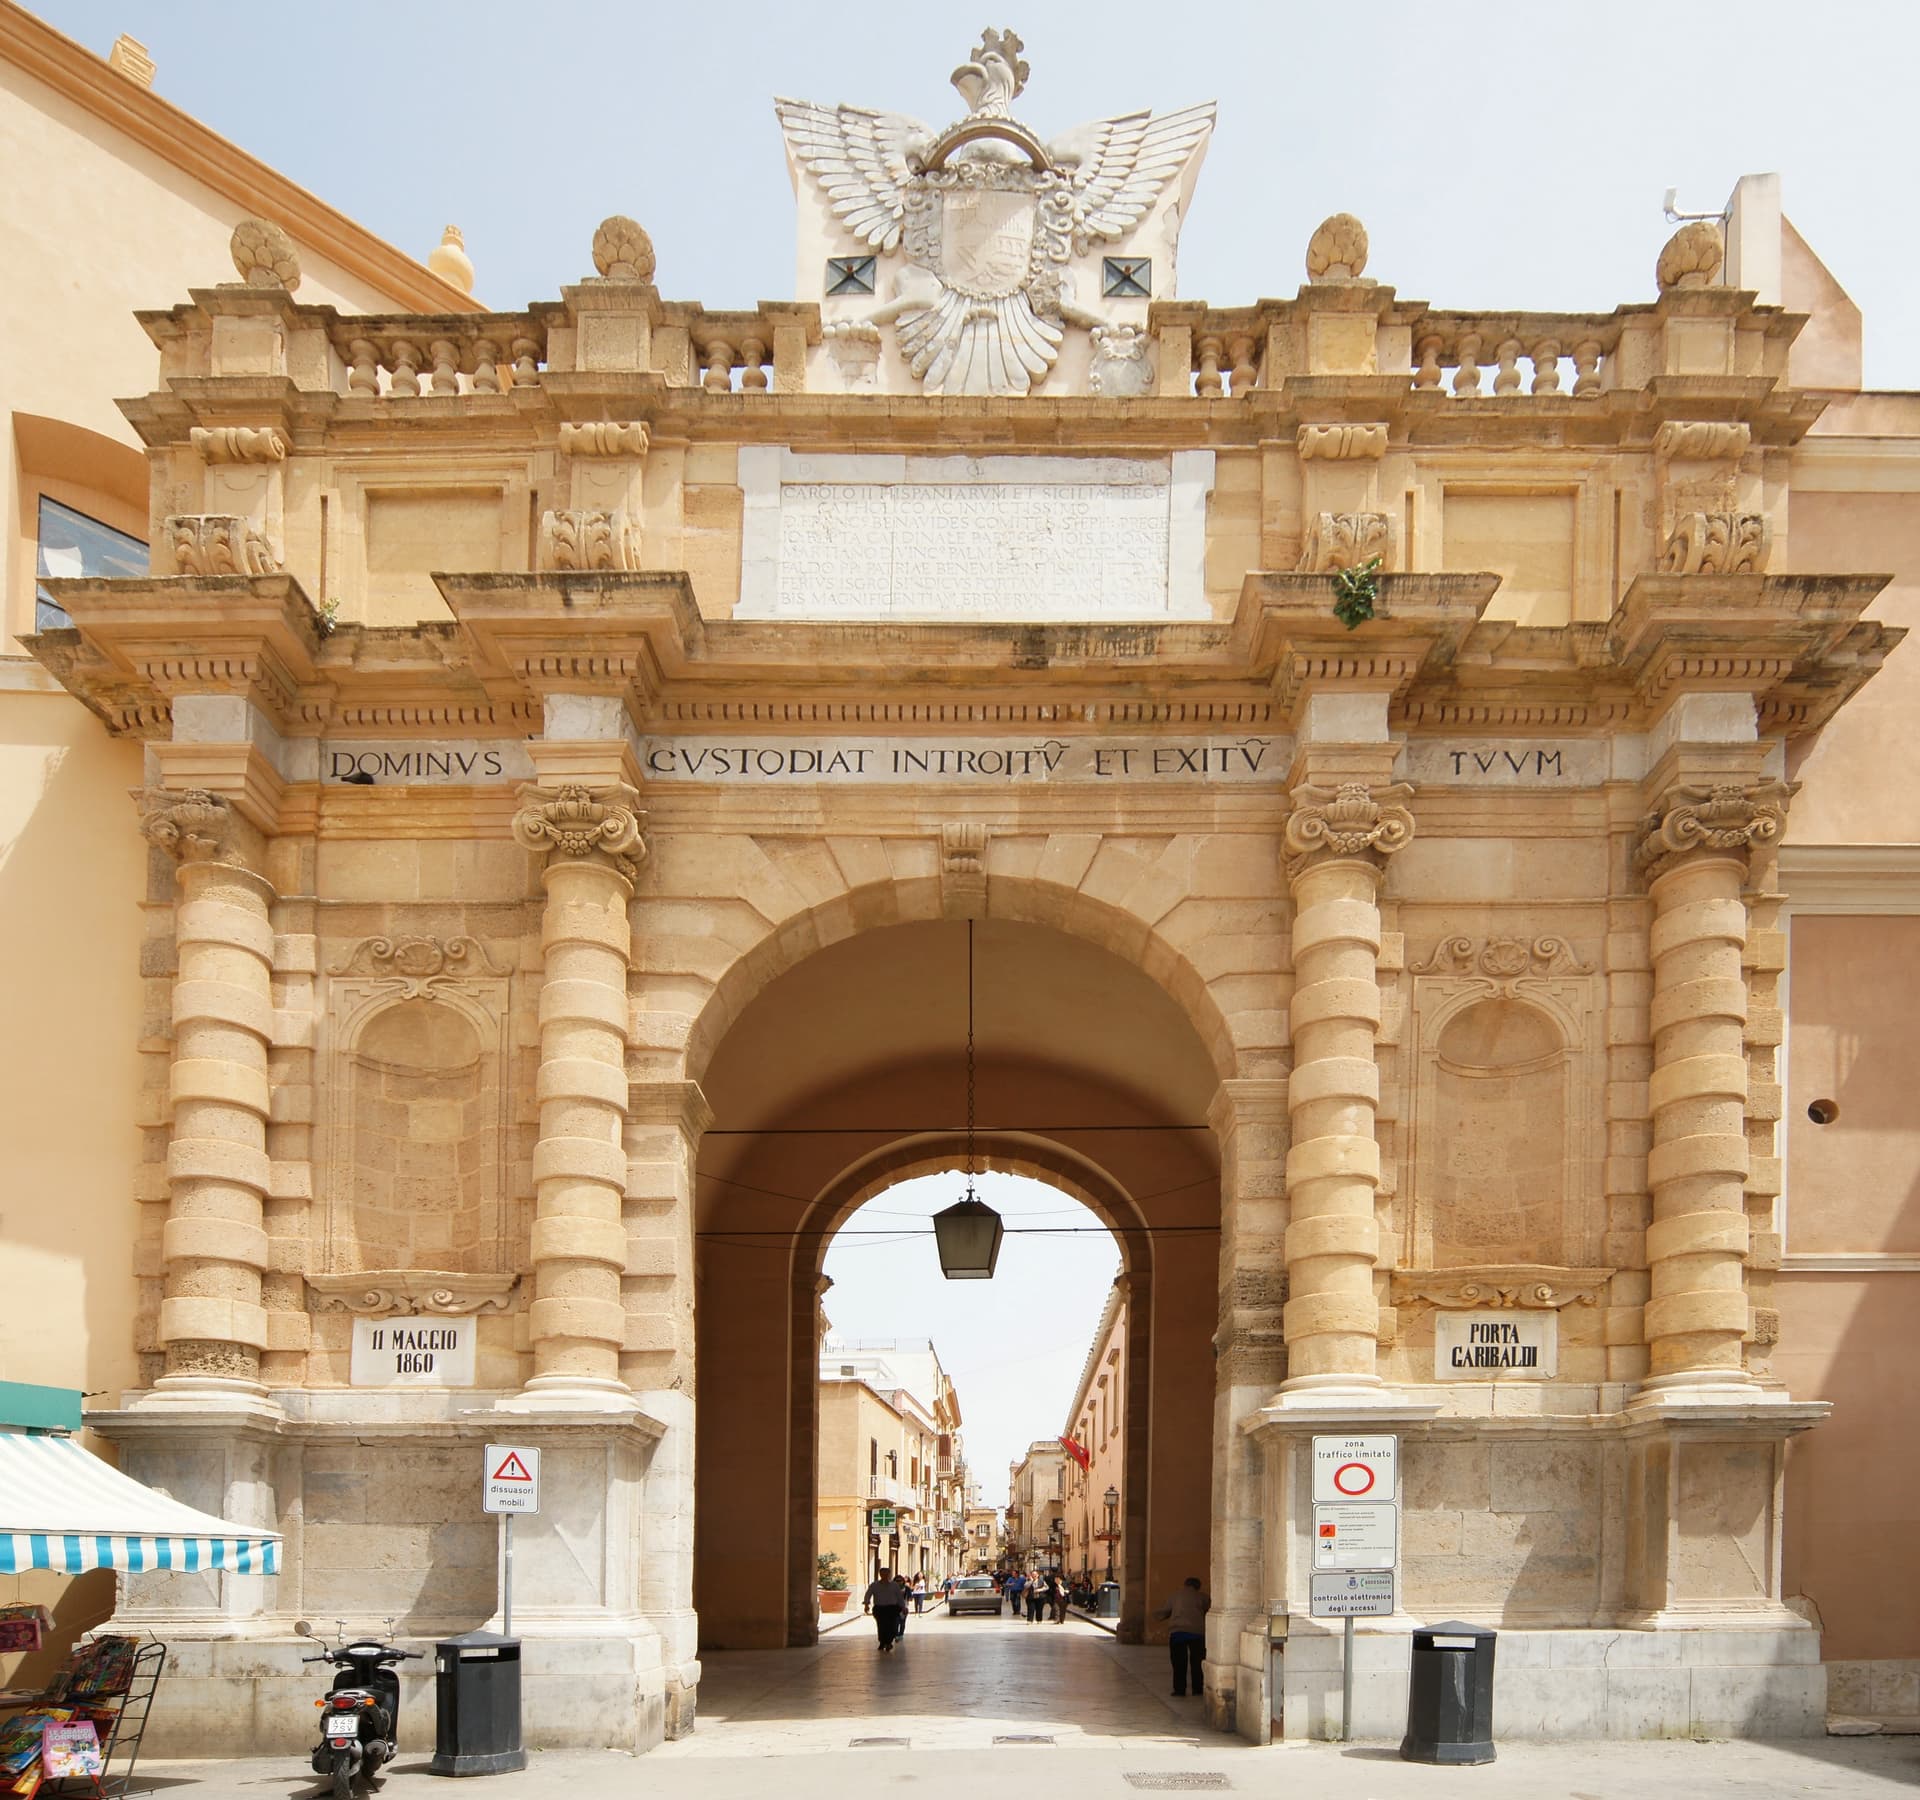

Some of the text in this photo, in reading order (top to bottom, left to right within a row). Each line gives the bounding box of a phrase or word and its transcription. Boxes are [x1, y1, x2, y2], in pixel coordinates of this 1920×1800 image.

[784, 486, 856, 500] CAROLO
[1012, 486, 1034, 500] ET
[1120, 486, 1168, 500] REGE
[330, 751, 504, 779] DOMINVS
[650, 747, 875, 776] CVSTODIAT
[1094, 748, 1138, 775] ET
[1449, 750, 1562, 777] TVVM
[392, 1329, 457, 1350] MAGGIO
[1469, 1323, 1520, 1344] PORTA
[396, 1352, 434, 1373] 1860
[1451, 1345, 1538, 1368] GARIBALDI
[1318, 1450, 1391, 1459] traffico limitato
[490, 1485, 533, 1495] dissuasori
[499, 1498, 525, 1507] mobili
[1313, 1593, 1391, 1602] controllo elettronico
[1328, 1605, 1347, 1613] degli
